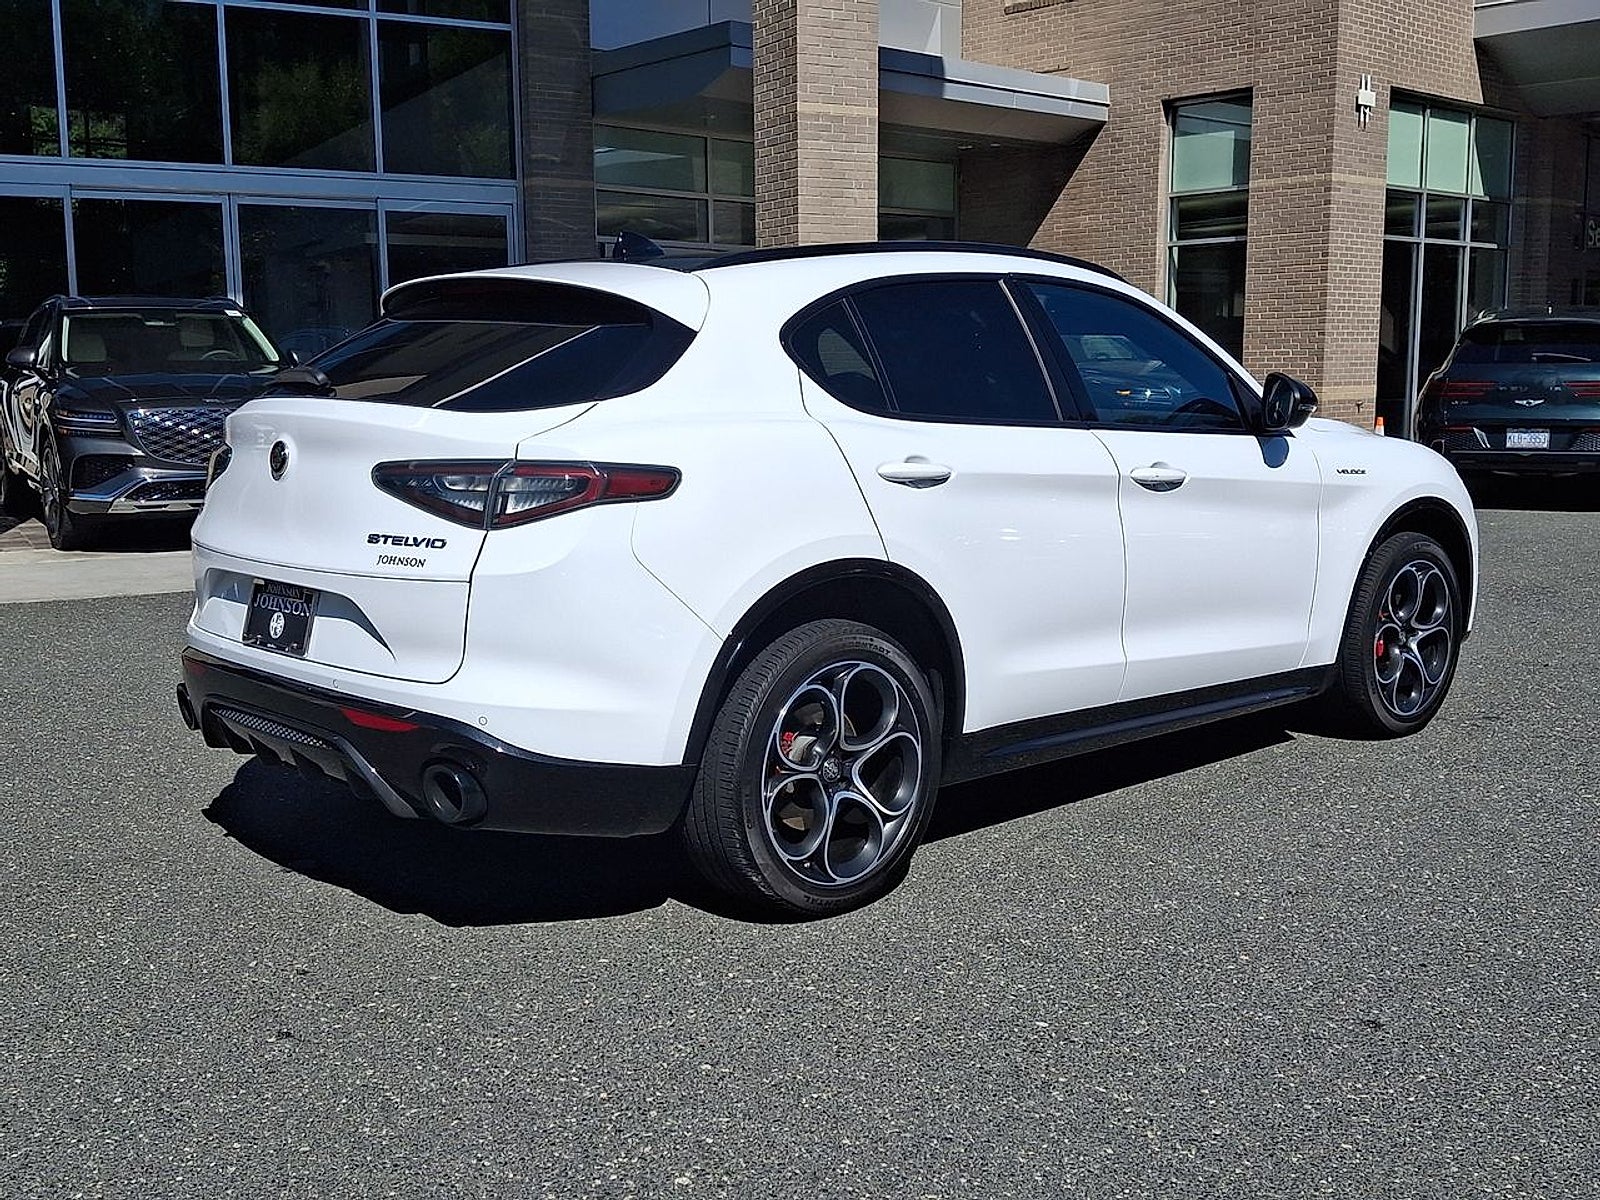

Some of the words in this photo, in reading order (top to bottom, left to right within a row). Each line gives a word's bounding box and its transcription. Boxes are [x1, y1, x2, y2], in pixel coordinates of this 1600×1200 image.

[367, 533, 447, 549] STELVIO
[376, 554, 427, 568] JOHNSON
[253, 593, 311, 618] JOHNSON
